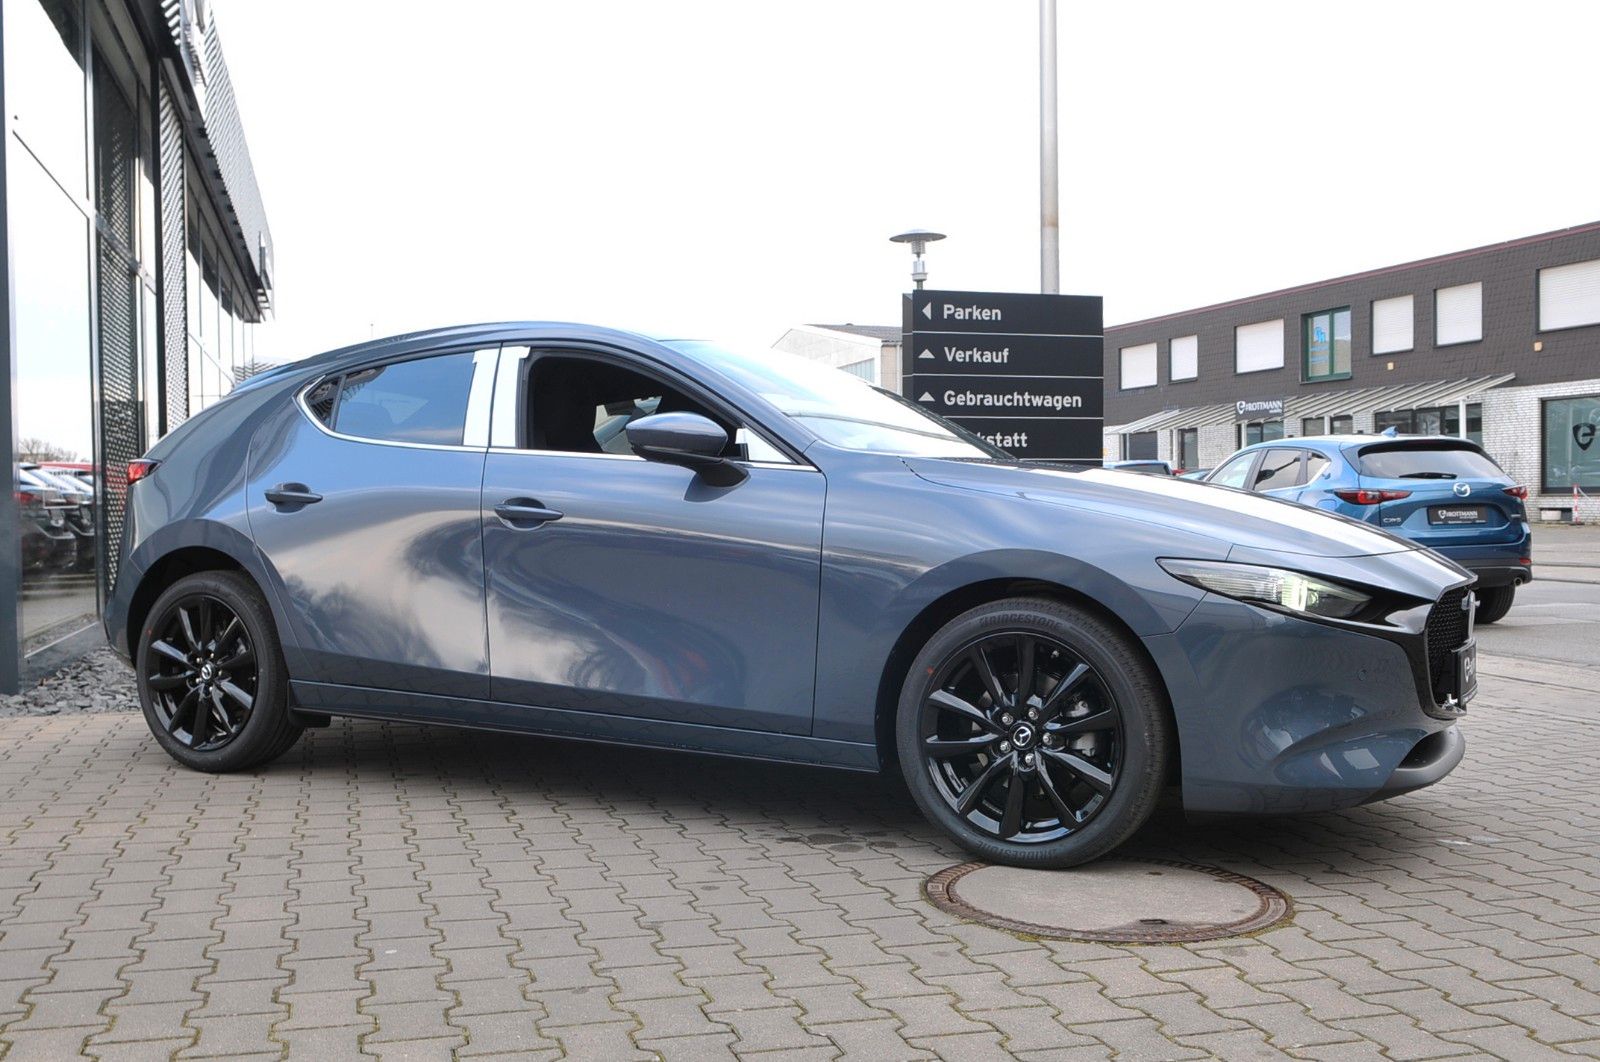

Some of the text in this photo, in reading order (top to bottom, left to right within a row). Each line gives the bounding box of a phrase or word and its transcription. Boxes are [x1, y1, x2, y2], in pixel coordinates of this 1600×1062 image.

[943, 304, 1002, 321] Parken
[944, 347, 1009, 363] Verkauf
[943, 390, 1082, 410] Gebrauchtwagen
[976, 432, 1028, 448] statt
[979, 613, 1062, 629] BRIDGESTONE
